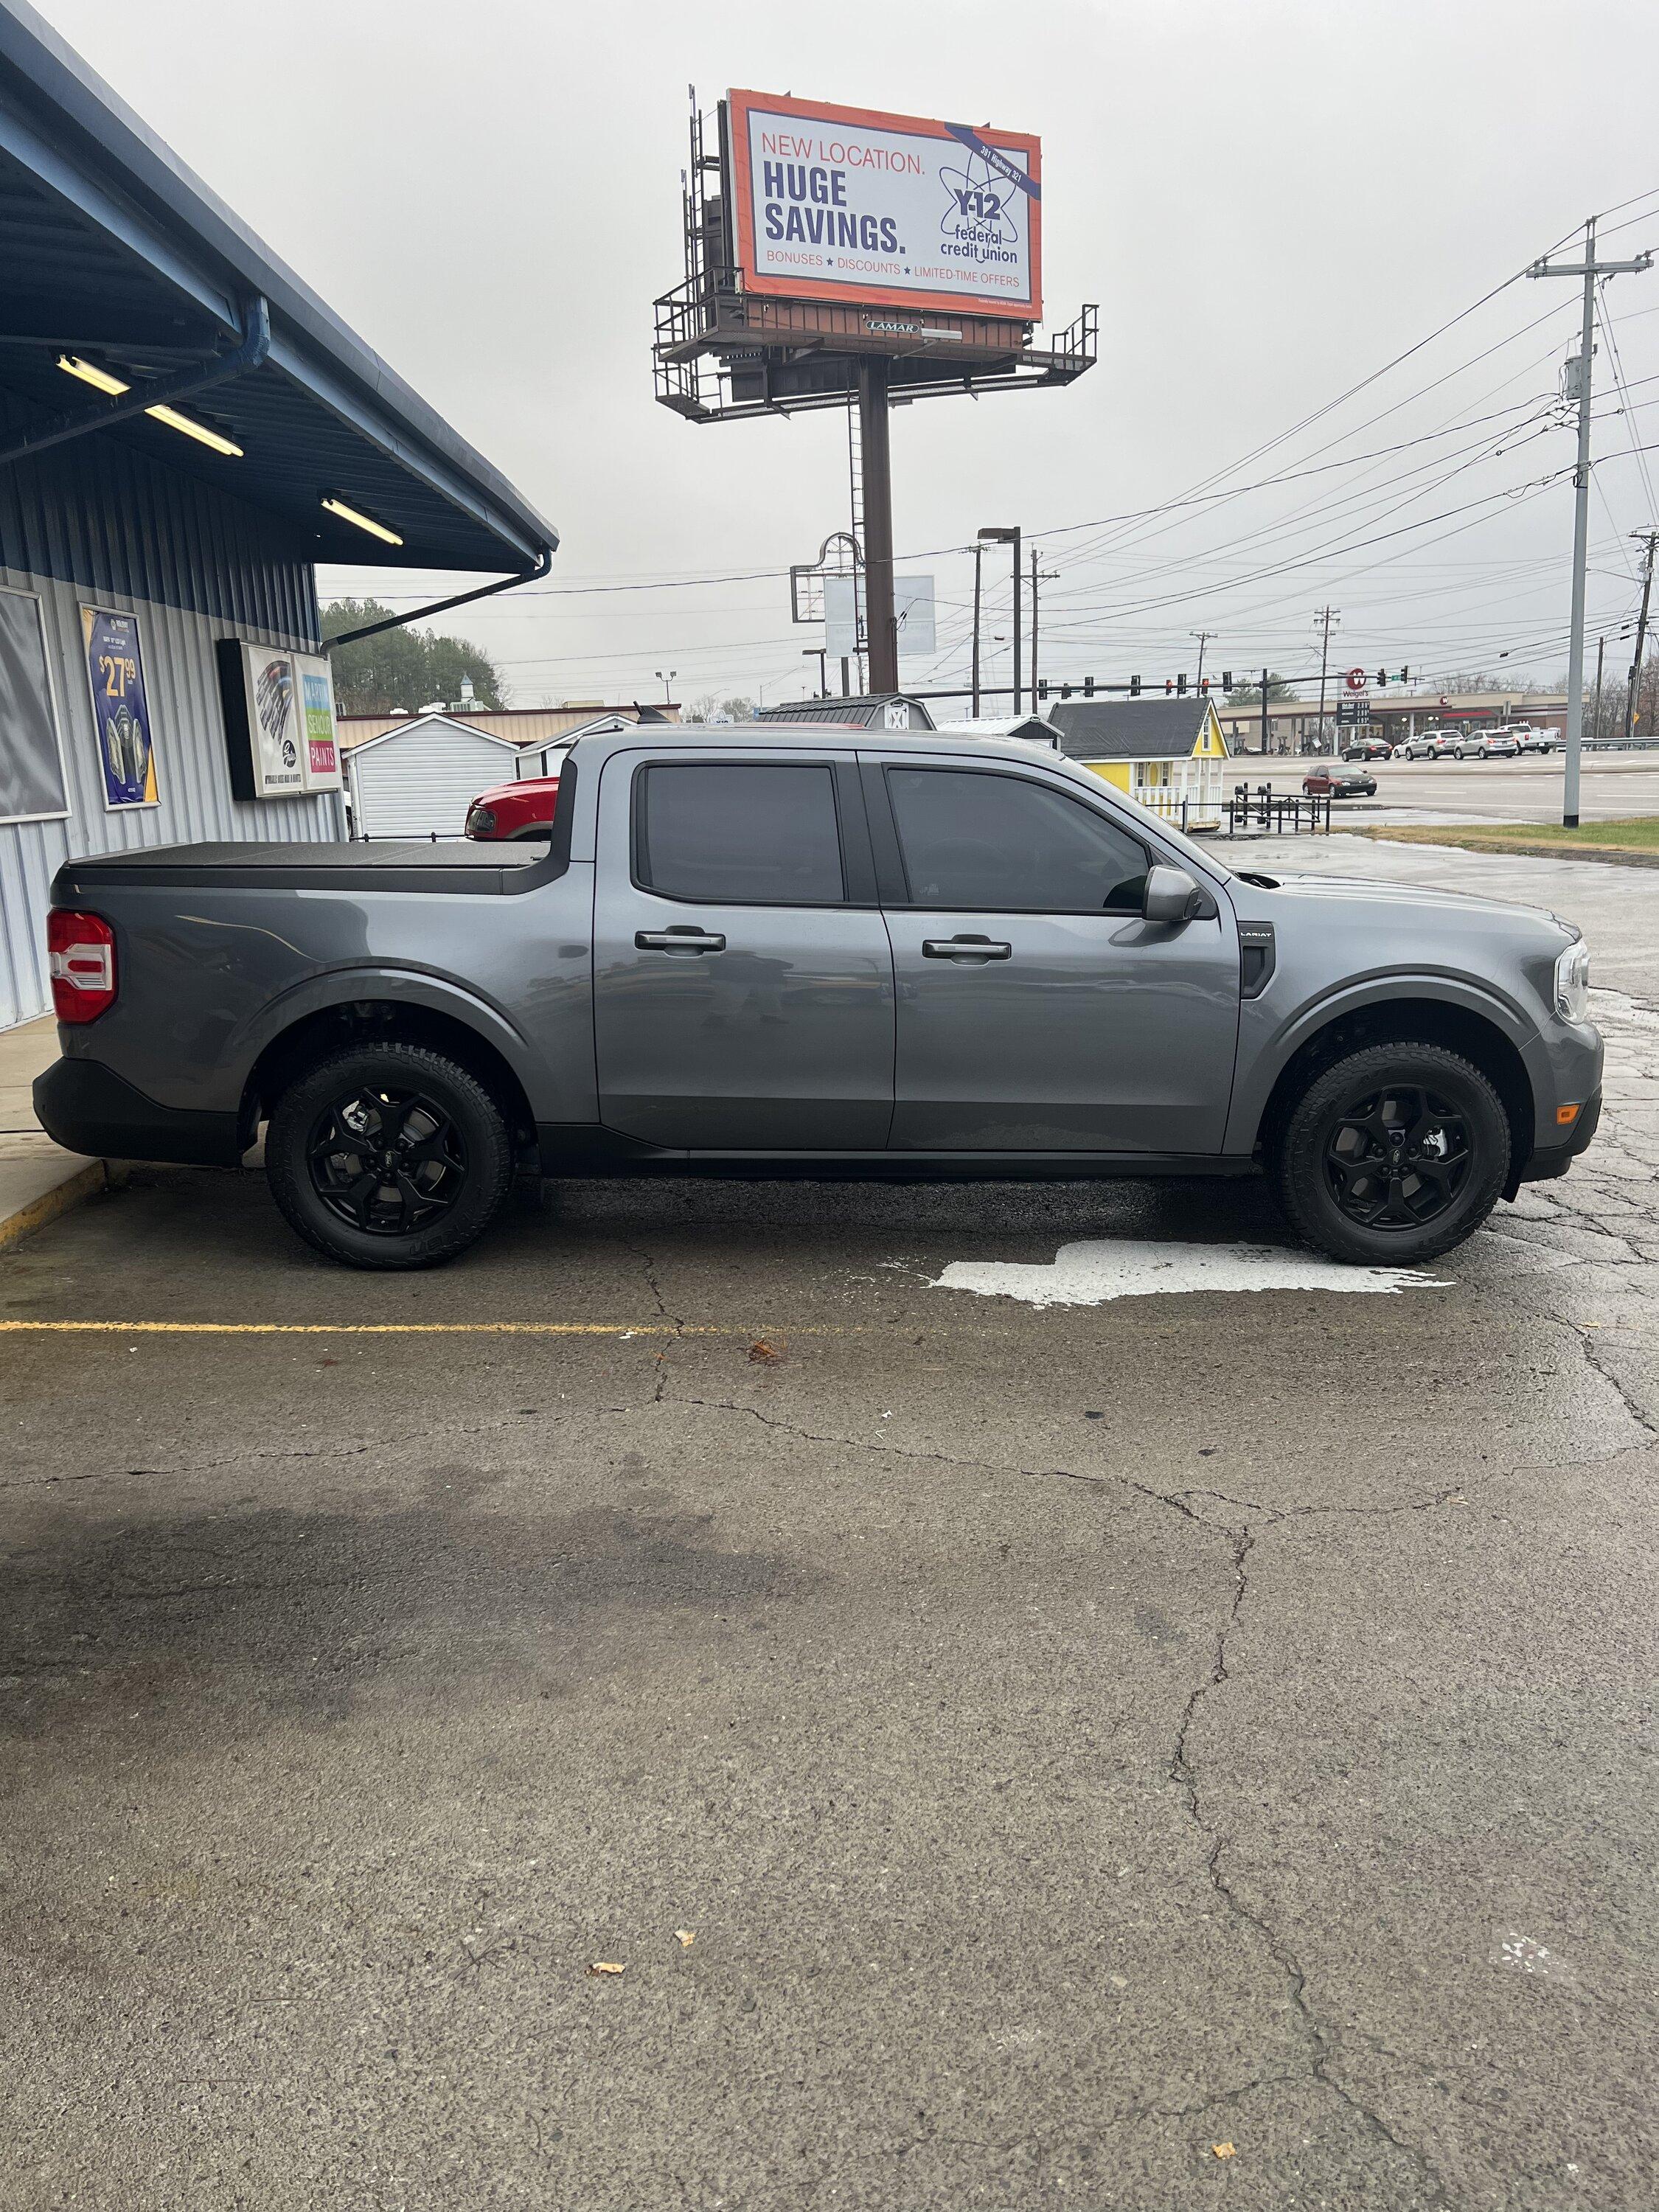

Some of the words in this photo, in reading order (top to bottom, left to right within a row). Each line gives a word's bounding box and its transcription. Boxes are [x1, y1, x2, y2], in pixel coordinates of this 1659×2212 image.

[762, 132, 813, 159] NEW
[820, 140, 925, 175] LOCATION.
[980, 145, 992, 159] 391
[991, 153, 1012, 176] Highway
[1012, 170, 1022, 182] 321
[764, 161, 847, 206] HUGE
[953, 188, 1001, 220] Y-12
[765, 203, 906, 254] SAVINGS.
[955, 223, 1001, 245] federal
[940, 242, 978, 258] credit
[982, 246, 1018, 263] union
[767, 250, 823, 266] BONUSES
[838, 257, 900, 274] DISCOUNTS
[914, 266, 978, 282] LIMITED-TIME
[981, 273, 1020, 288] OFFERS
[870, 321, 914, 332] LAMAR
[305, 681, 329, 703] MARTIN
[1343, 689, 1368, 698] Weigel's
[307, 714, 331, 734] SENOUR
[310, 747, 334, 766] PAINTS
